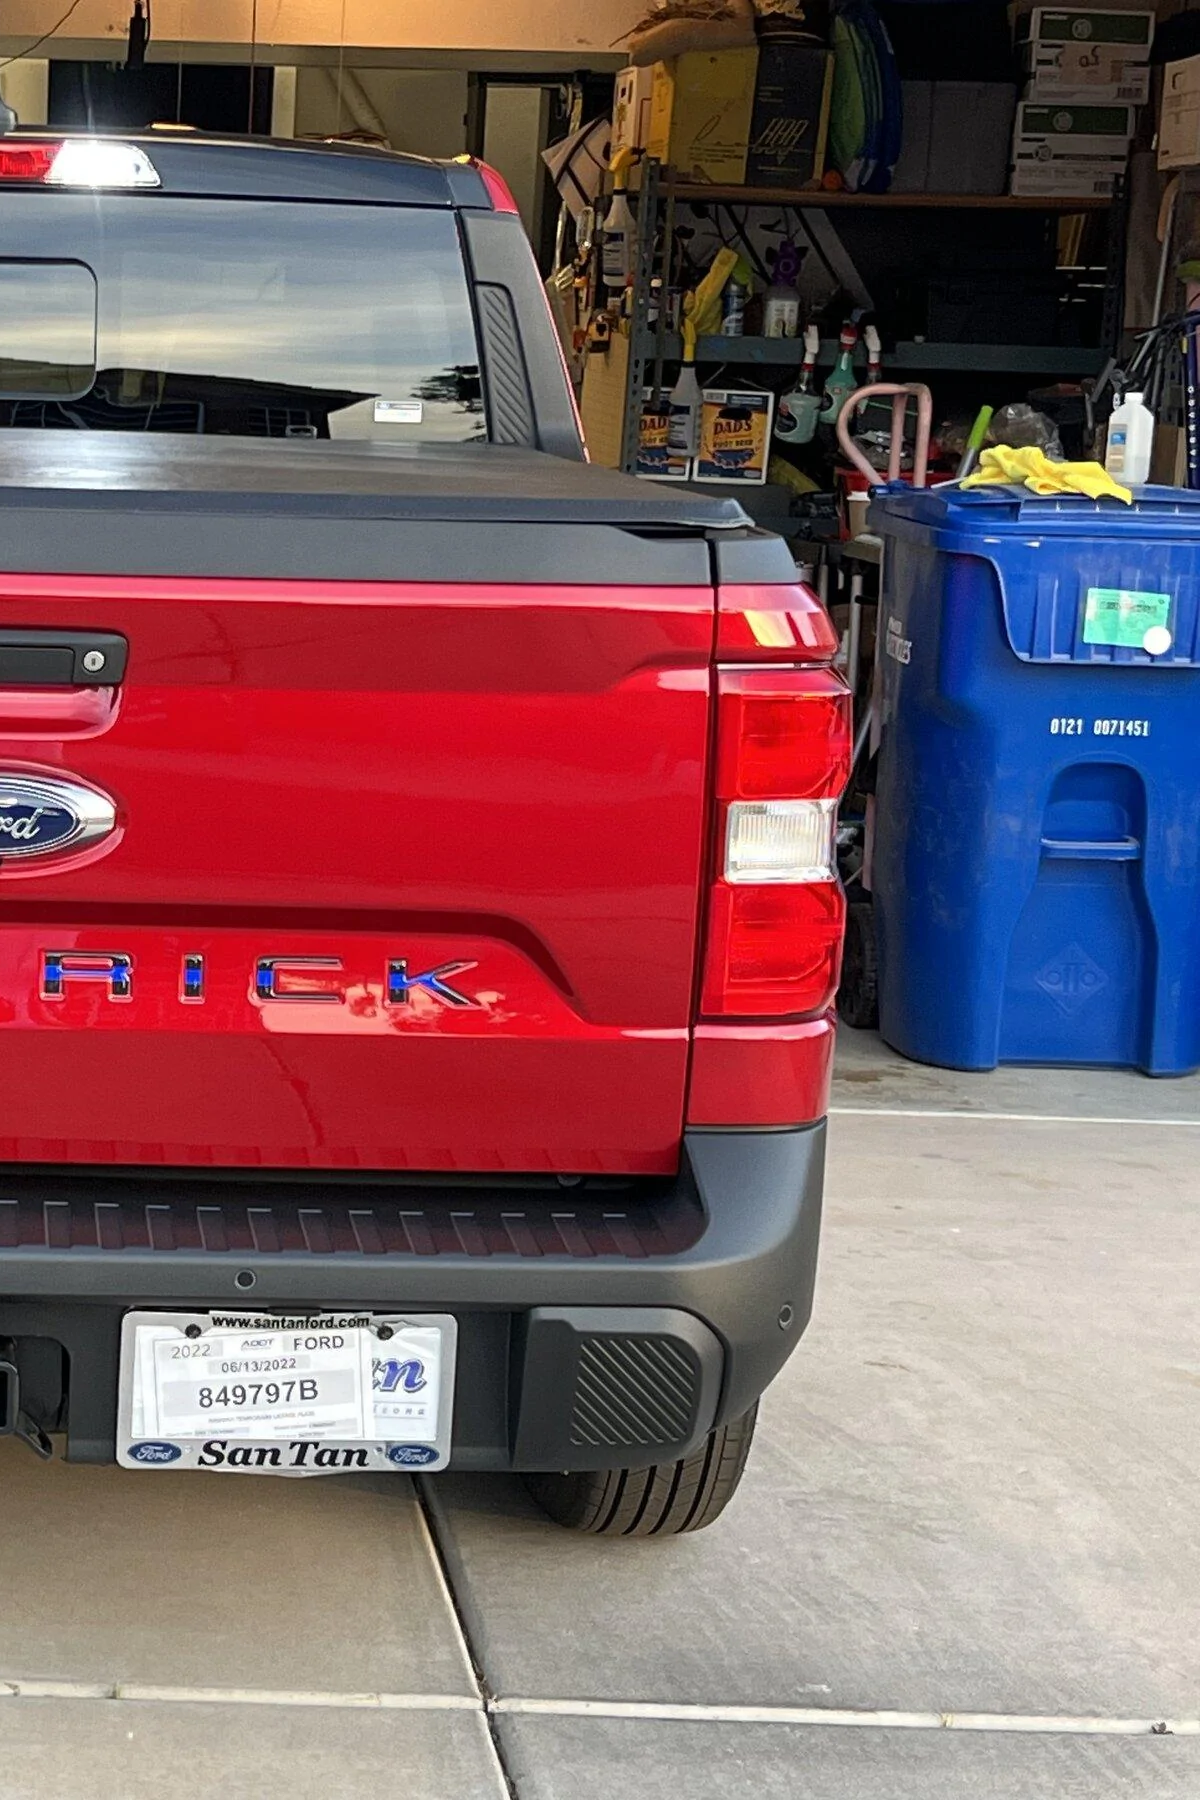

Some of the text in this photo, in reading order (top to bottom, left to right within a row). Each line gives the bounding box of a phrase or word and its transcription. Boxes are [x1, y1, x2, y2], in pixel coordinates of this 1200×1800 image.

[1050, 718, 1149, 737] 0121 0071451
[211, 1315, 371, 1330] www.santanford.com
[171, 1343, 212, 1360] 2022
[293, 1335, 345, 1351] FORD
[221, 1358, 297, 1374] 06/13/2022
[199, 1379, 319, 1409] 849797B
[136, 1444, 173, 1461] Ford
[197, 1439, 370, 1468] San Tan
[393, 1446, 431, 1463] Ford
